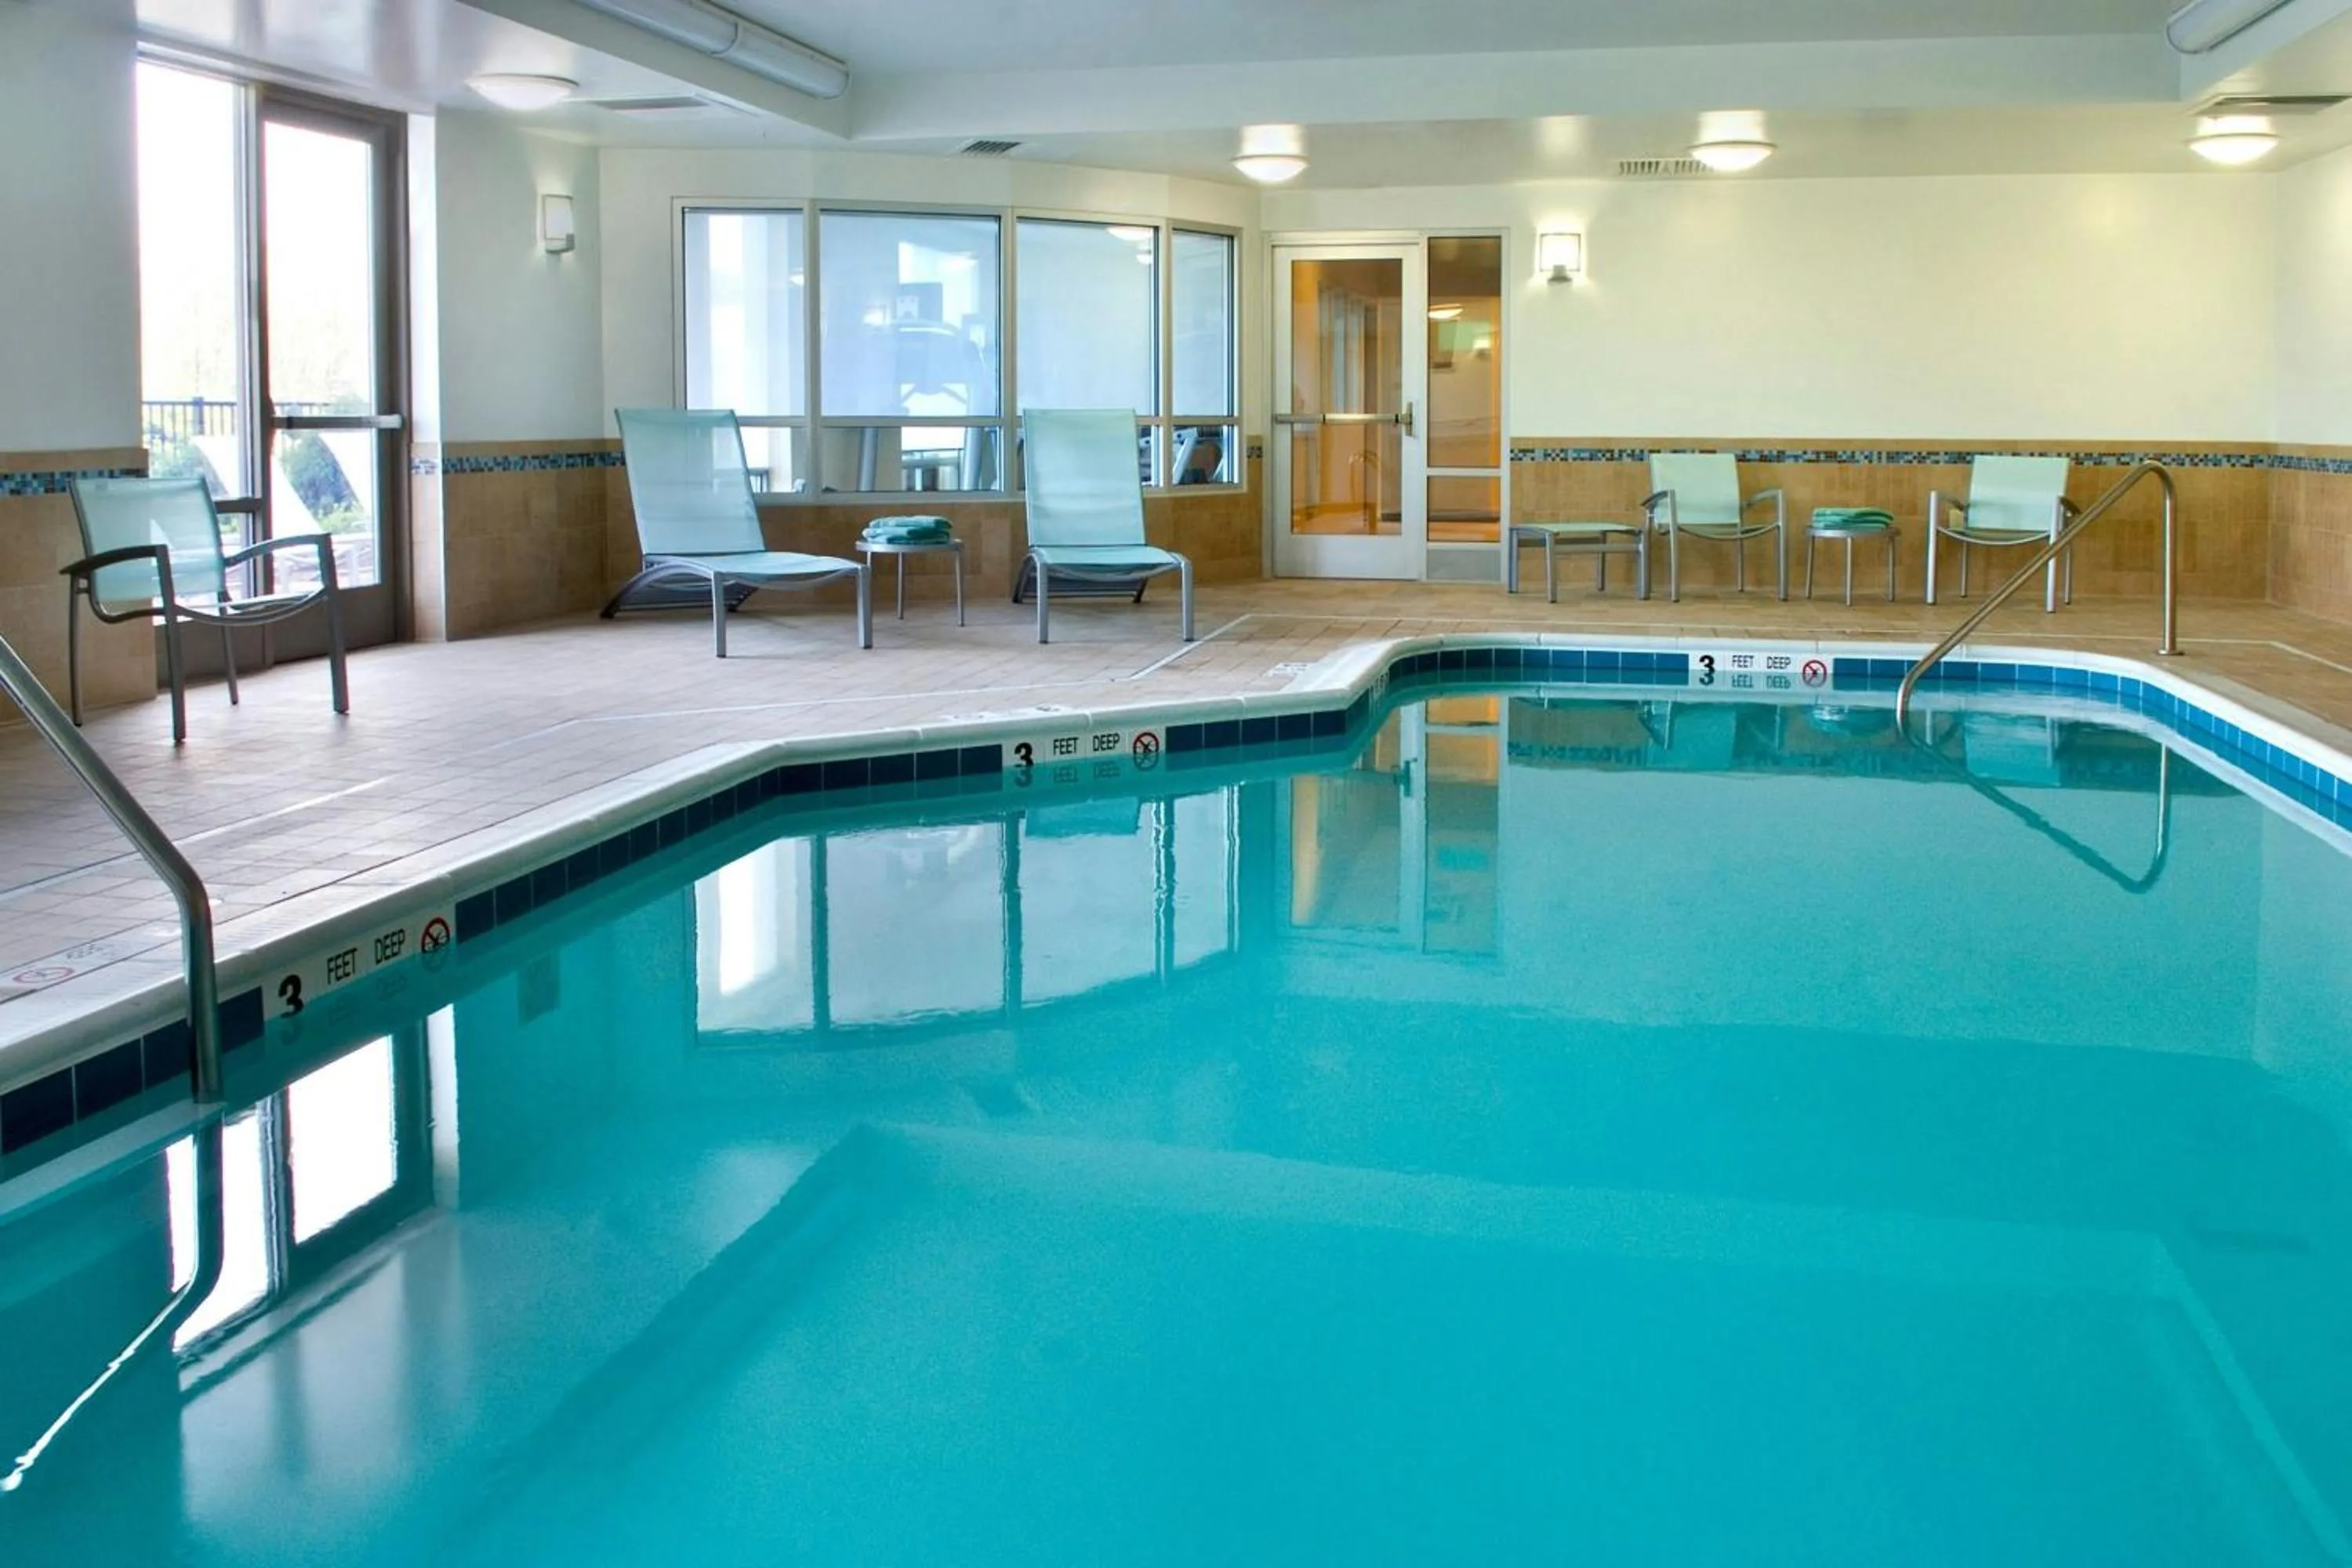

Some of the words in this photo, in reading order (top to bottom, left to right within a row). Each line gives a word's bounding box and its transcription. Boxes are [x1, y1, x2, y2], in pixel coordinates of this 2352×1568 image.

[1699, 655, 1715, 672] 3
[1732, 655, 1754, 668] FEET
[1766, 656, 1791, 669] DEEP
[1014, 742, 1033, 766] 3
[1054, 737, 1079, 755] FEET
[1093, 733, 1120, 752] DEEP
[278, 975, 304, 1018] 3
[327, 948, 358, 984] FEET
[374, 928, 405, 964] DEEP
